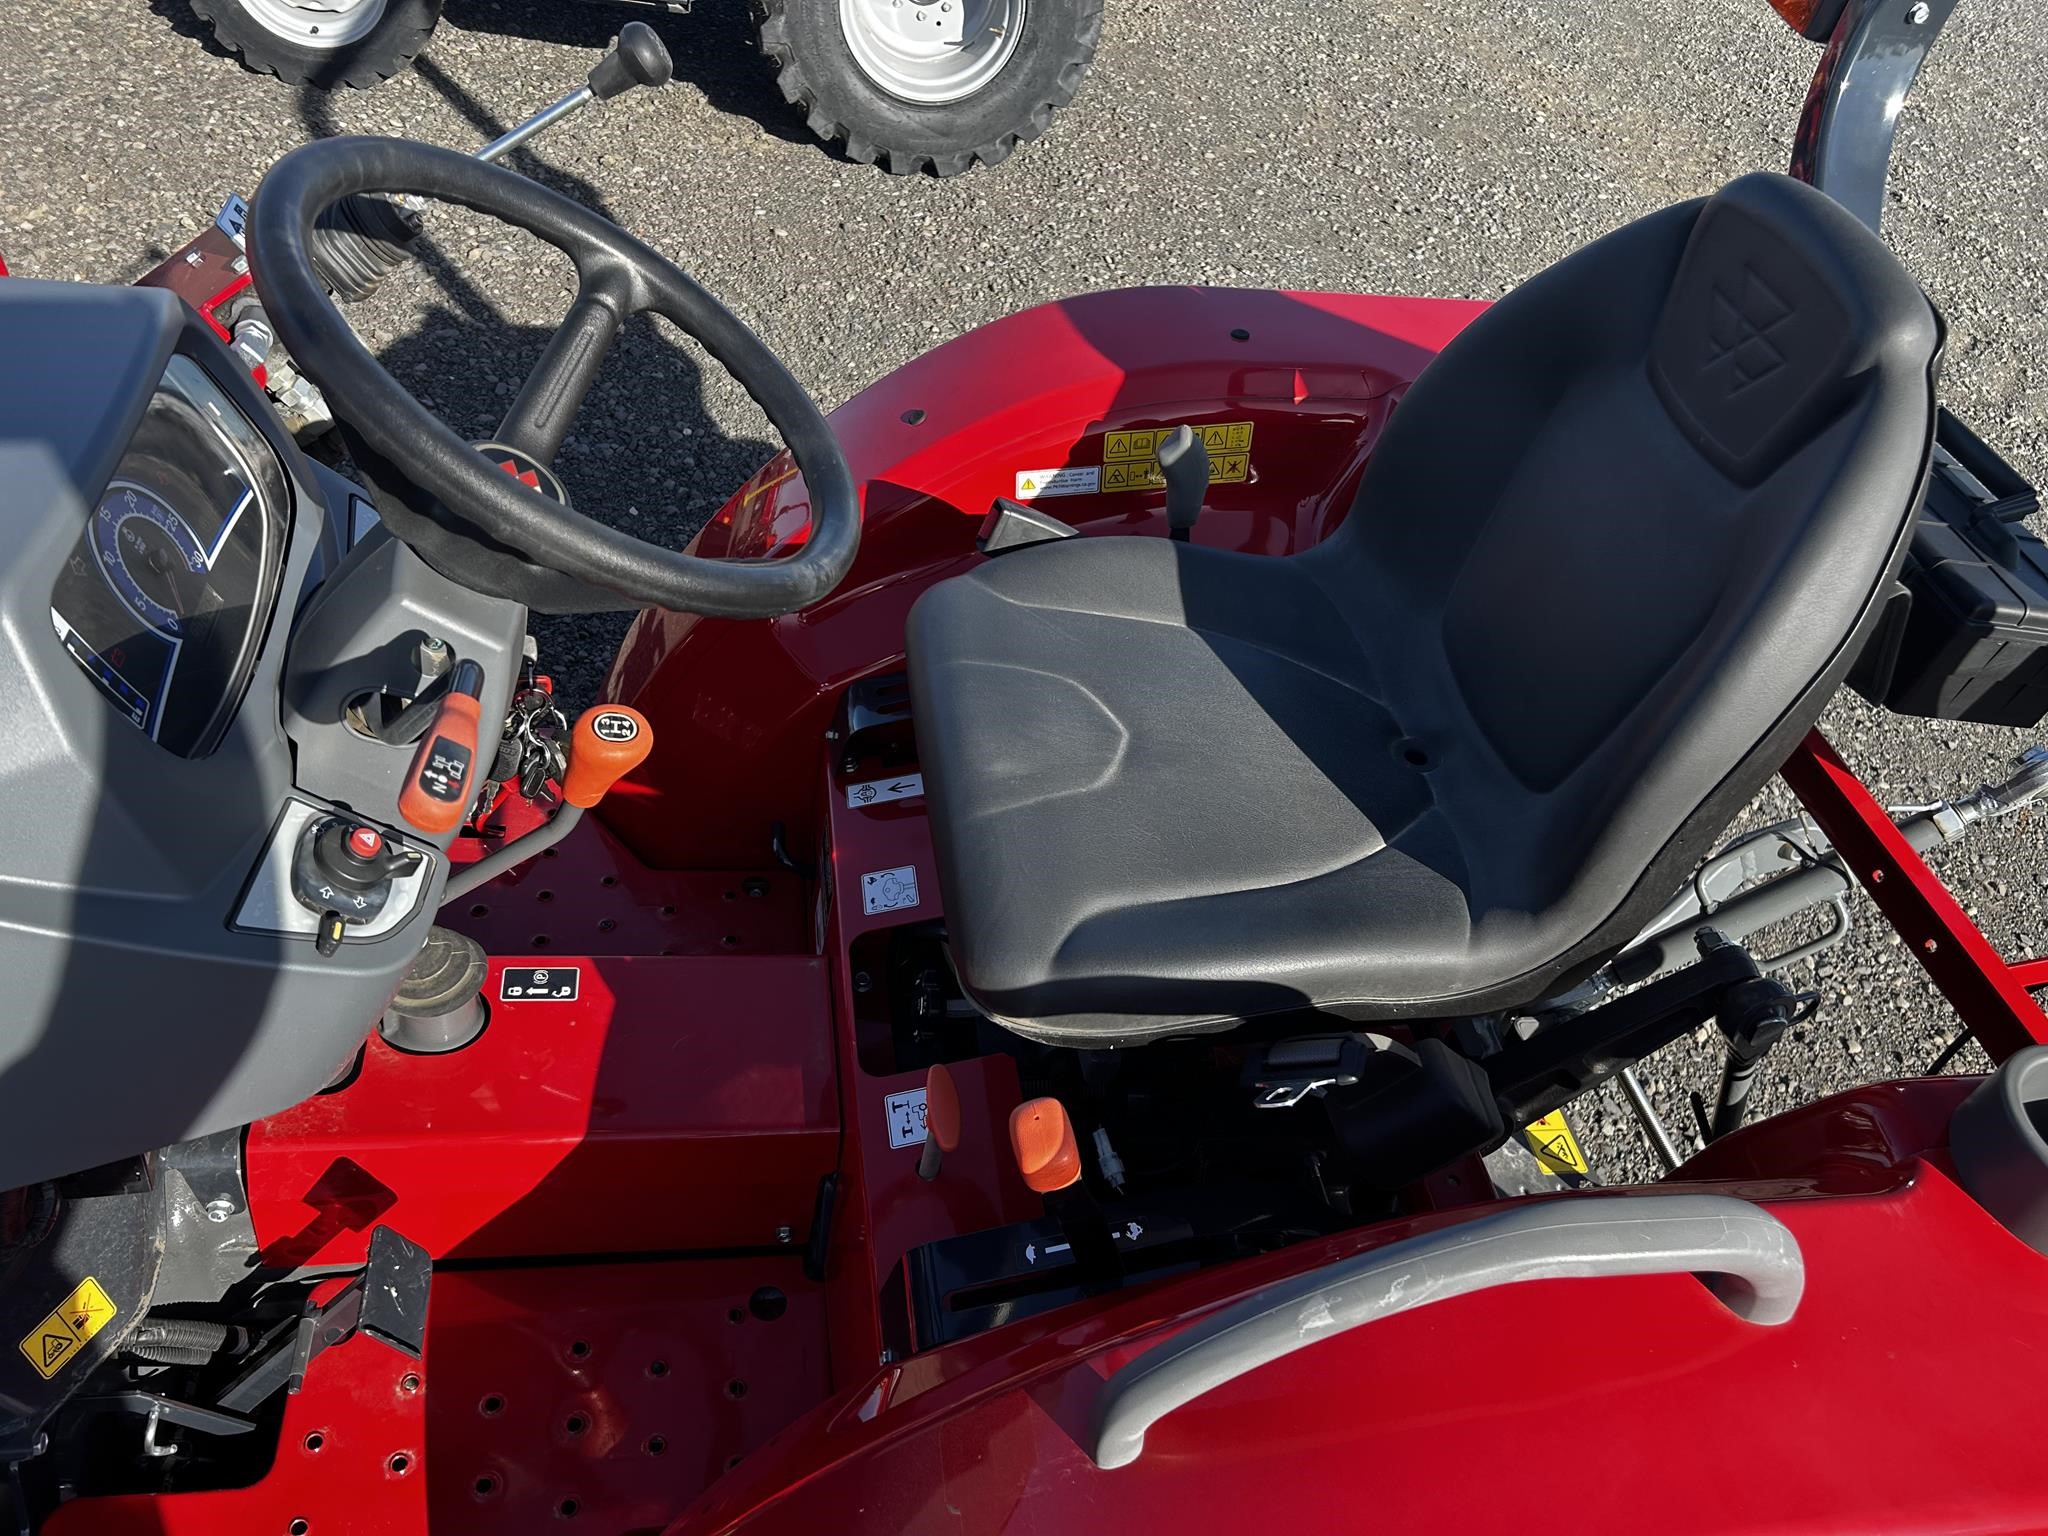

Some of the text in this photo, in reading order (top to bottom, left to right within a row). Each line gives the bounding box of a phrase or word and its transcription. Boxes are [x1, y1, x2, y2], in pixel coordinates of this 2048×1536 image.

[124, 490, 137, 508] 20
[99, 506, 111, 522] 15
[166, 513, 179, 532] 25
[103, 551, 115, 566] 10
[192, 550, 204, 568] 30
[135, 597, 146, 611] 5
[168, 618, 179, 630] 0
[131, 712, 141, 723] E
[432, 781, 447, 794] N
